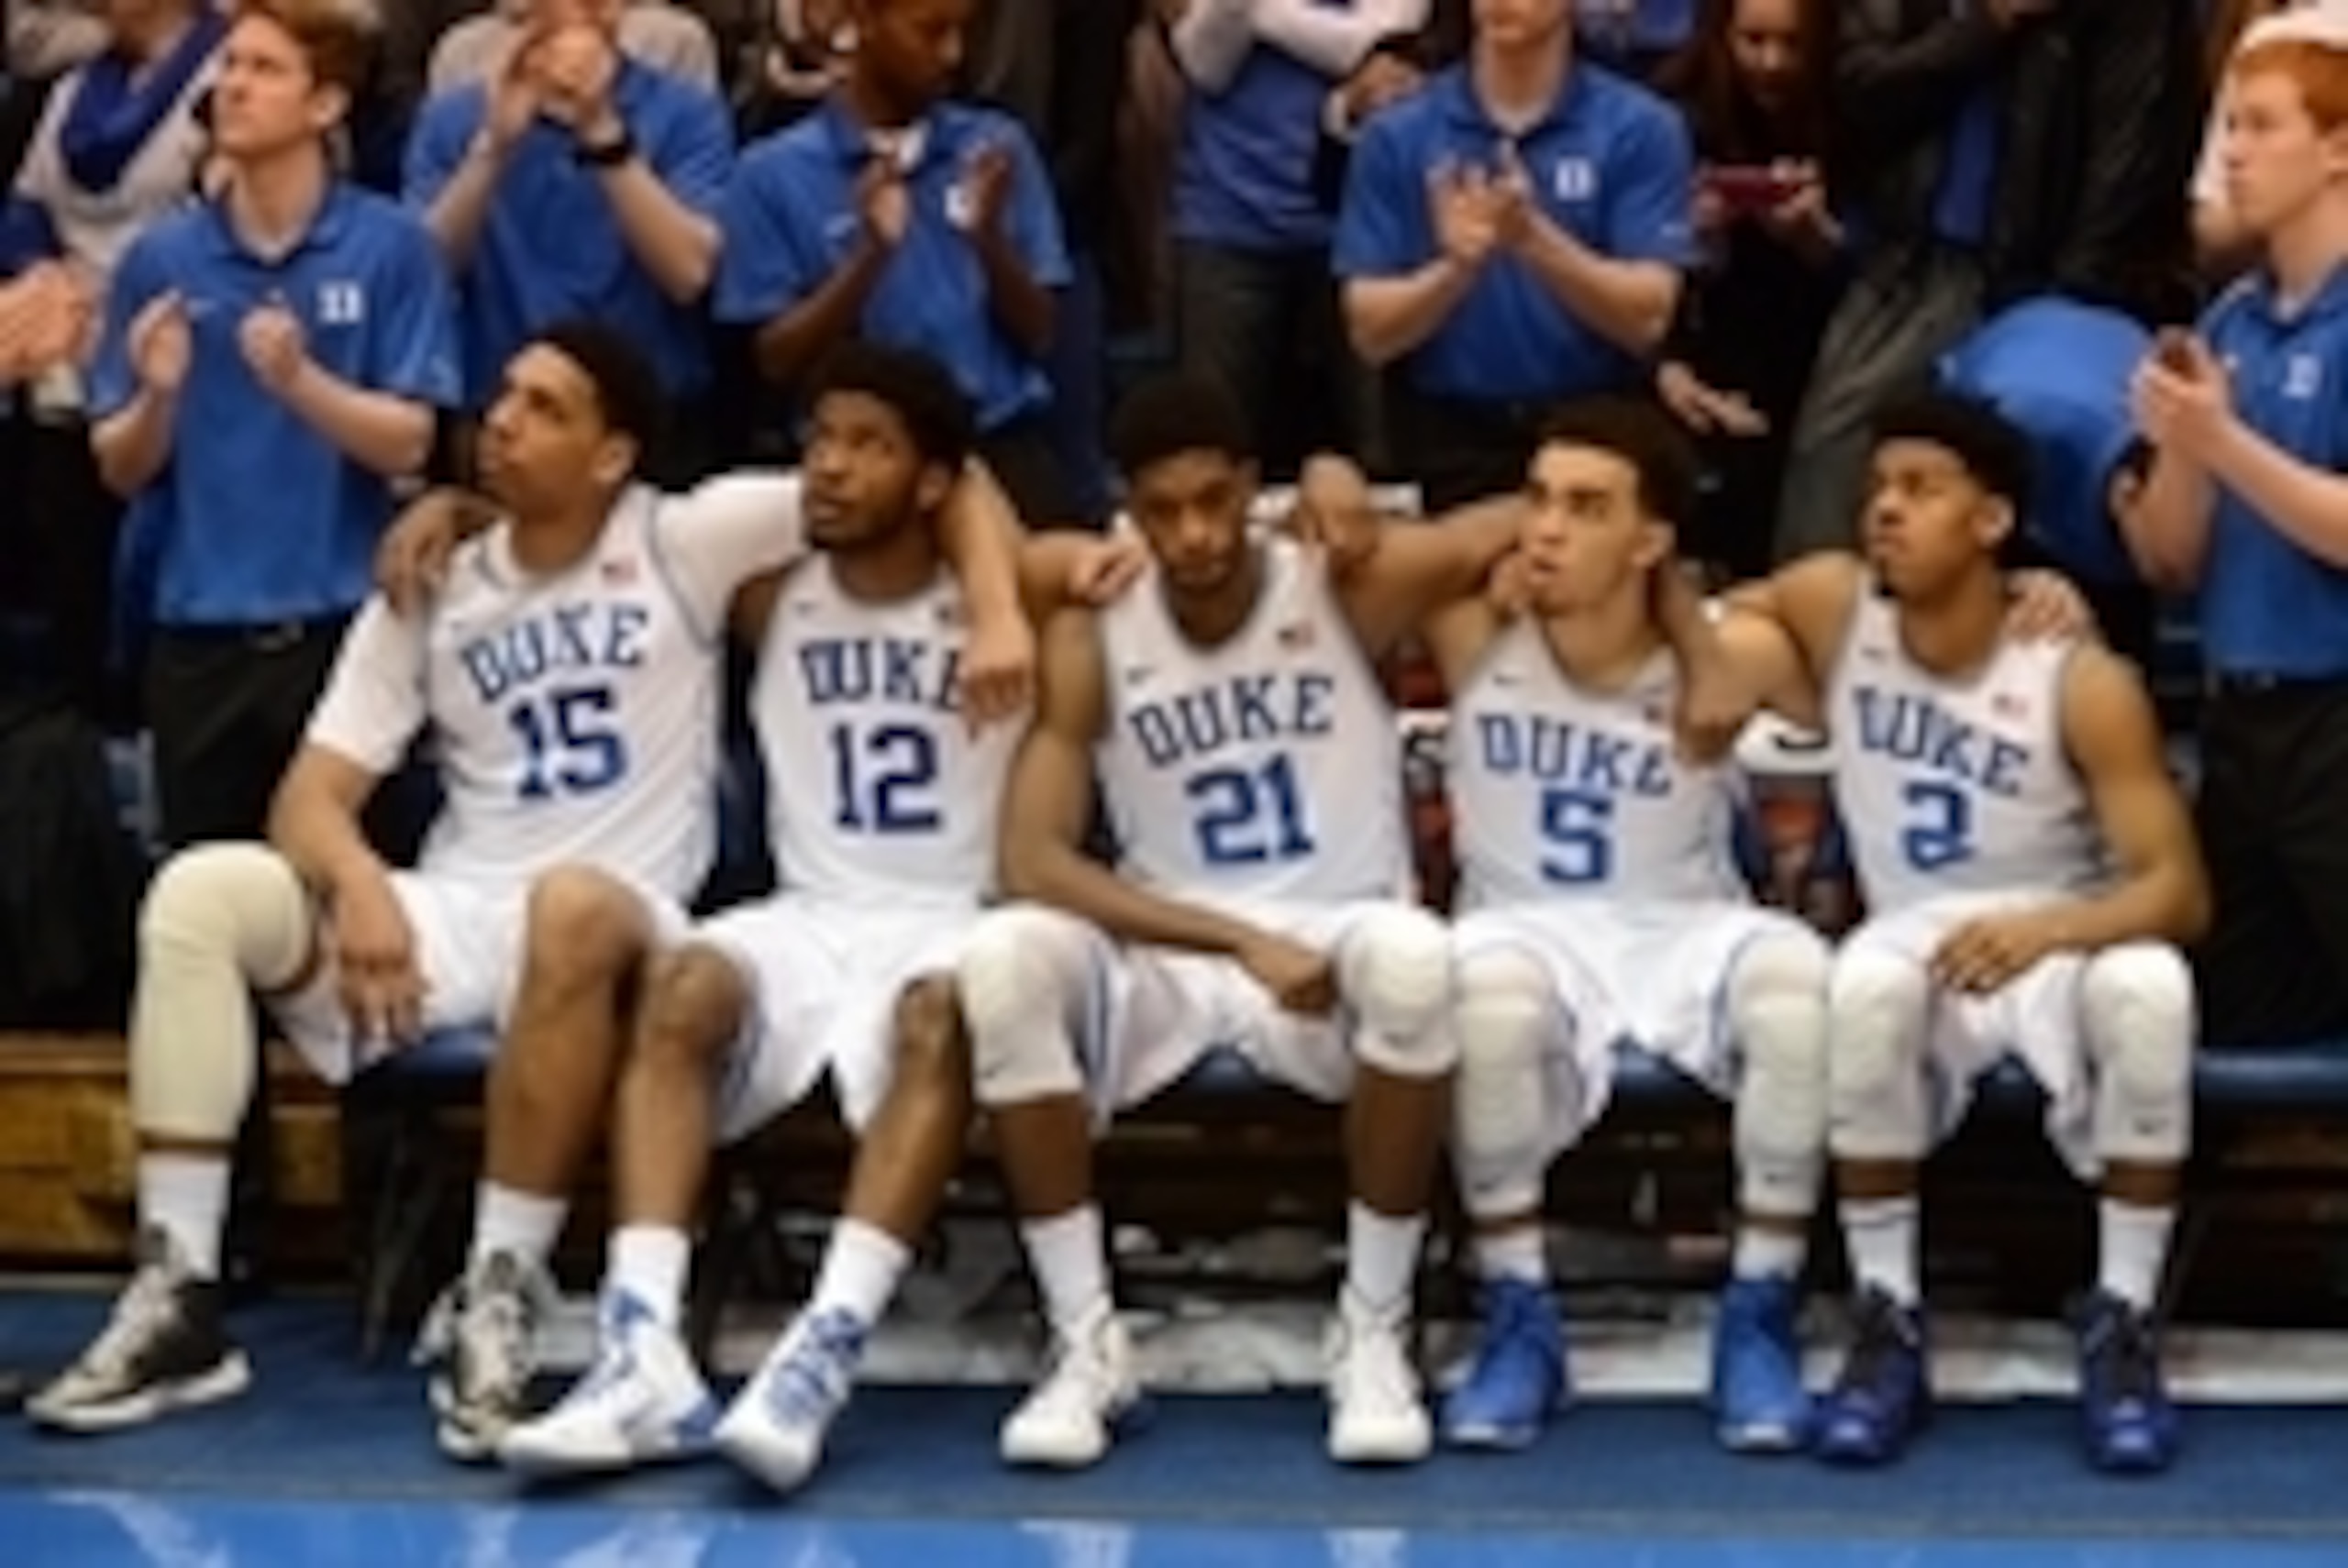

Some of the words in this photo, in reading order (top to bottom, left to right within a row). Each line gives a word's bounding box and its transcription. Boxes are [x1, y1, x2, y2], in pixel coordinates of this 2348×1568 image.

[460, 602, 648, 702] DUKE
[510, 685, 628, 798] 15
[1127, 673, 1334, 768] DUKE
[1476, 712, 1672, 797] DUKE
[1854, 686, 2030, 797] DUKE
[831, 723, 940, 834] 12
[1185, 752, 1315, 866] 21
[1901, 782, 1975, 871] 2
[1538, 789, 1613, 882] 5
